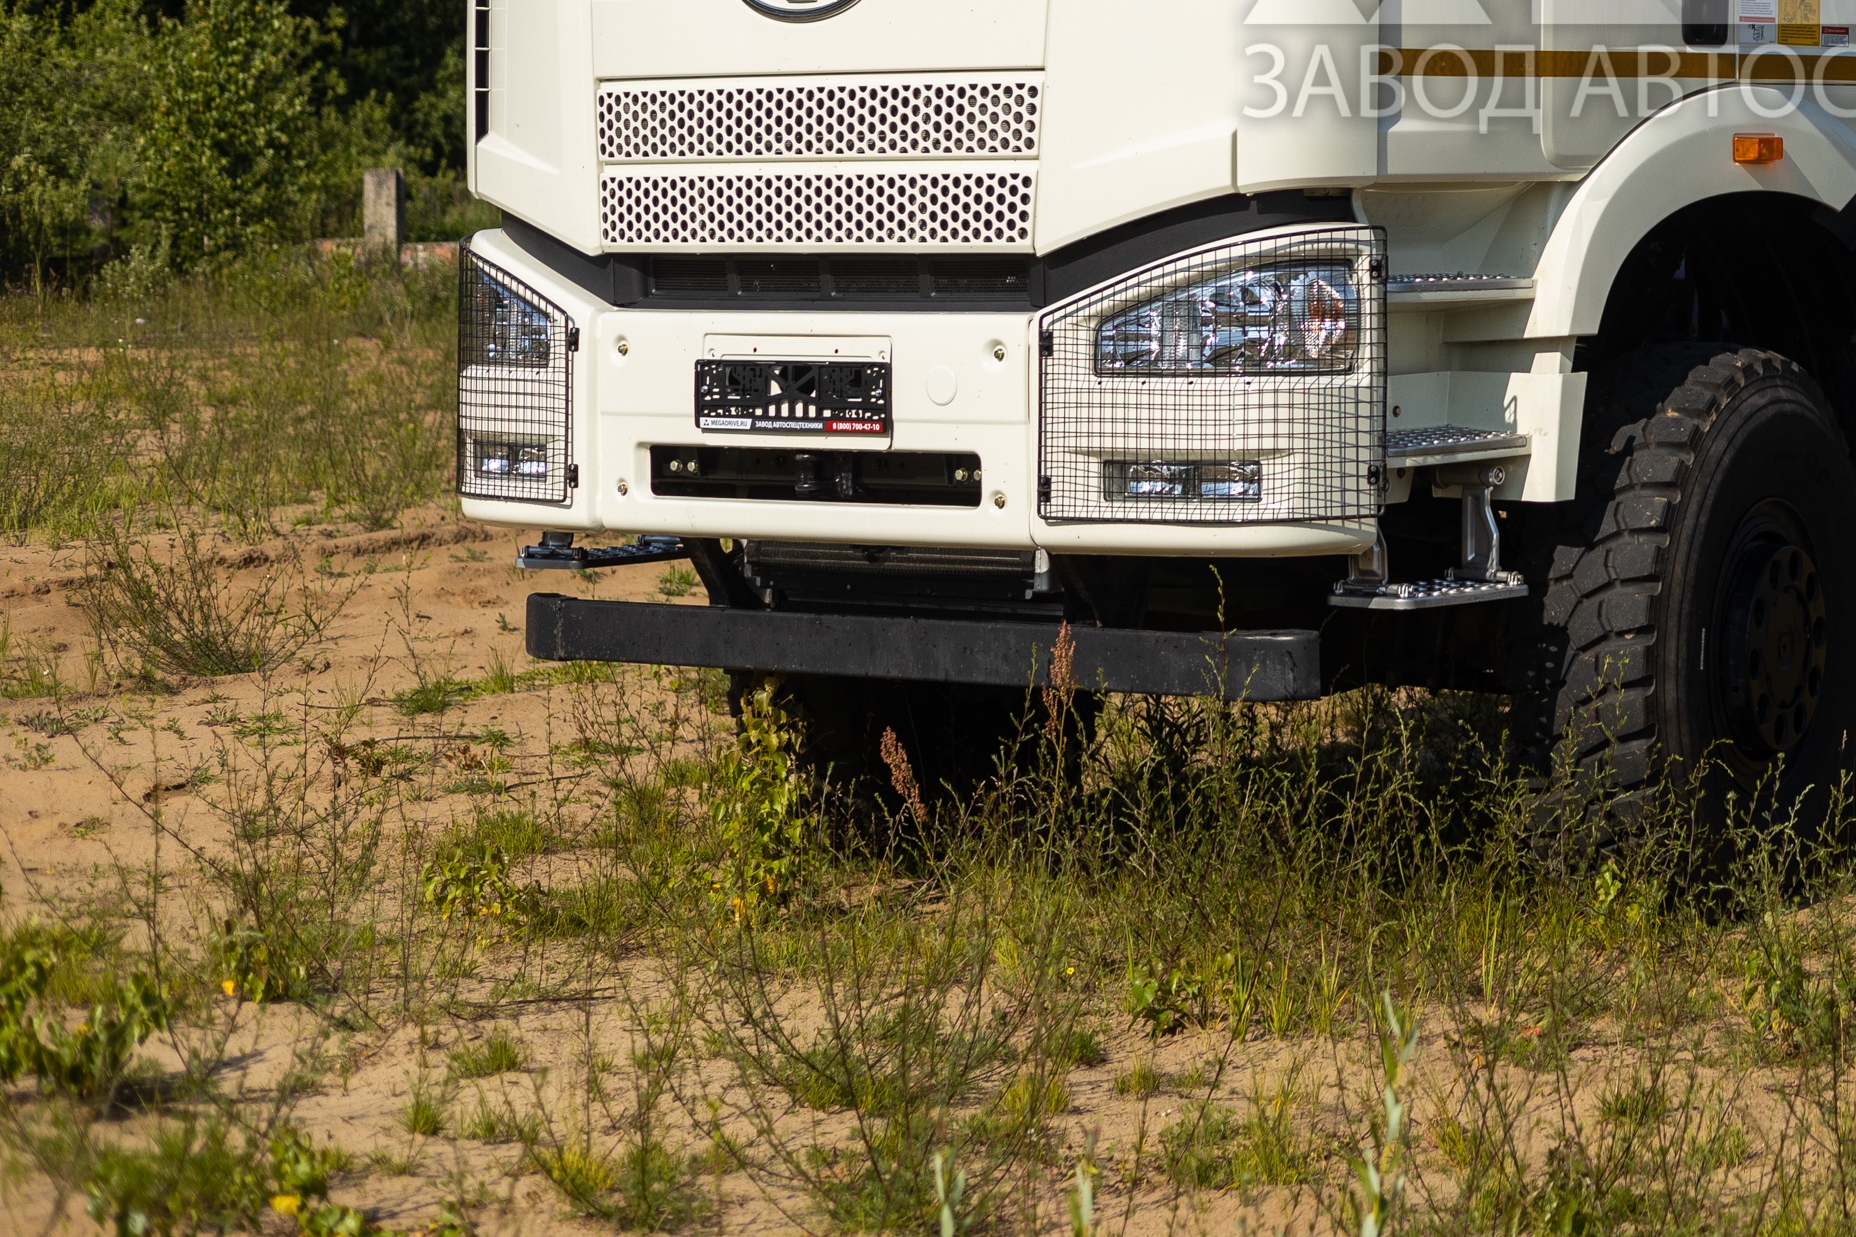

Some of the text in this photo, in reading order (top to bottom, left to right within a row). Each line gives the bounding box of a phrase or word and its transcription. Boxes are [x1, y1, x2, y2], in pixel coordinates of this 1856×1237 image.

[710, 419, 748, 427] MEGADRIVE.RU
[755, 420, 823, 430] ЗАВОД АВТОСПЕЦТЕХНИКИ
[837, 422, 851, 431] (800)
[851, 423, 880, 431] 700-47-10
